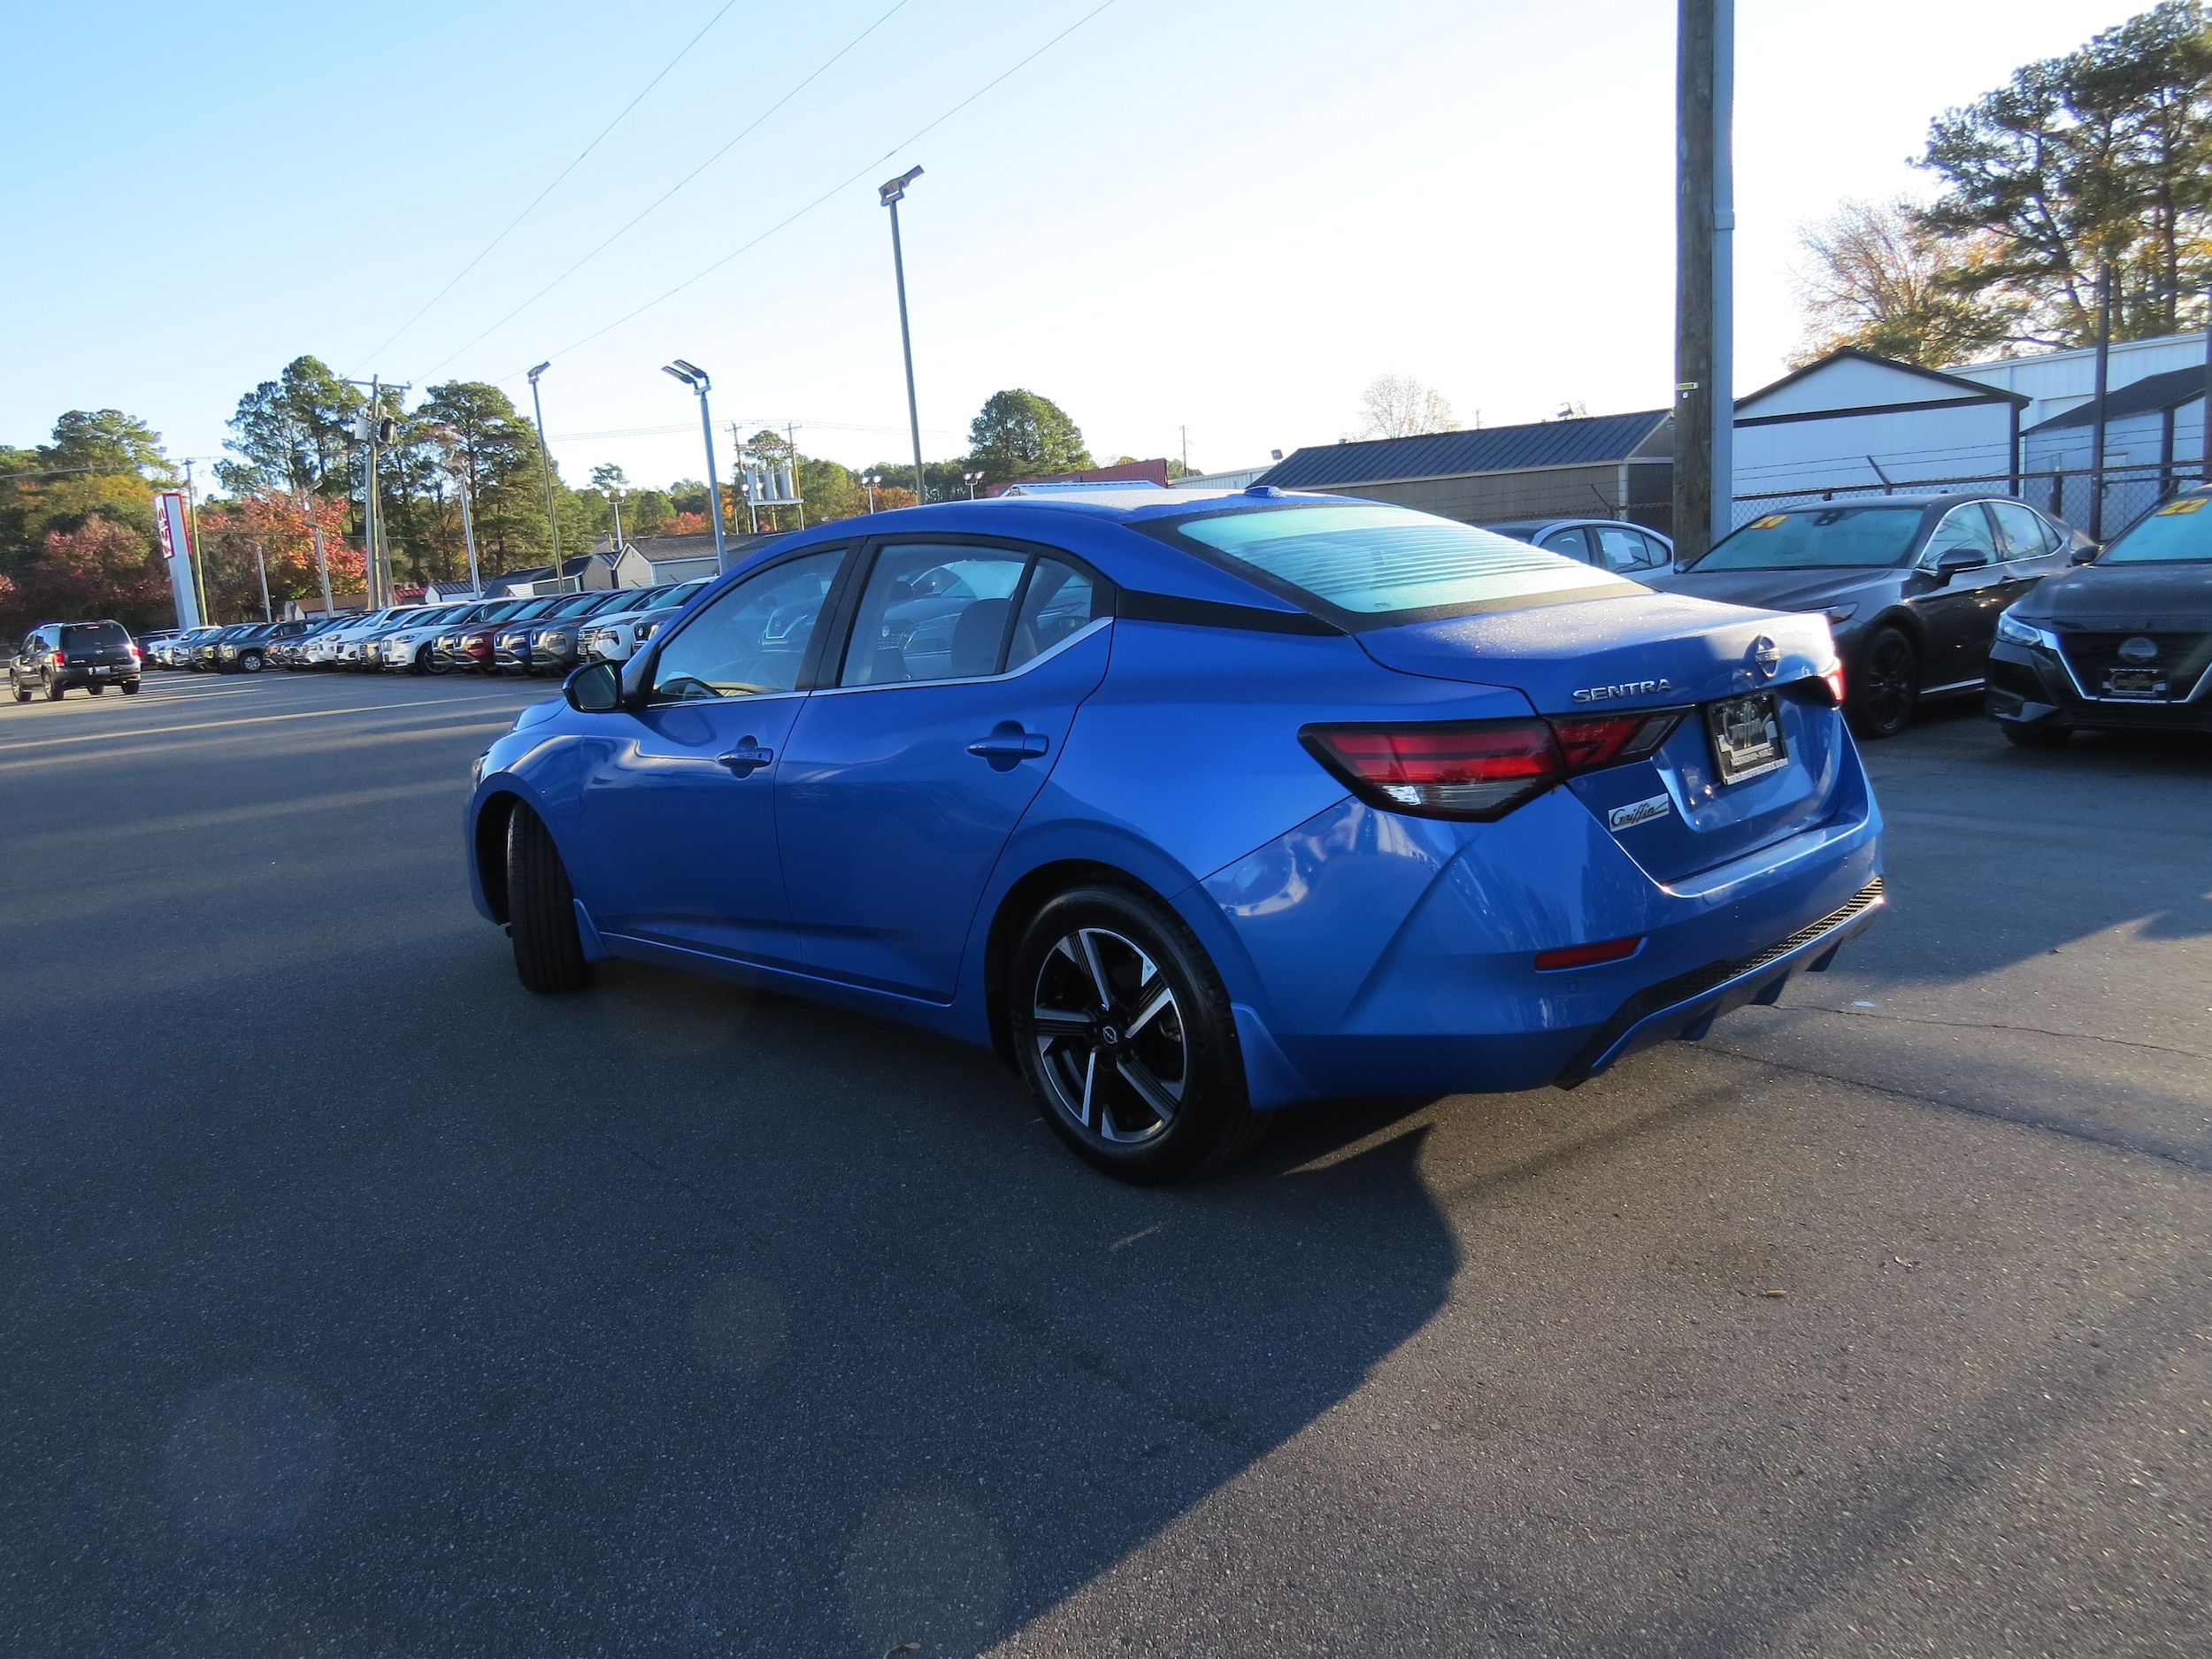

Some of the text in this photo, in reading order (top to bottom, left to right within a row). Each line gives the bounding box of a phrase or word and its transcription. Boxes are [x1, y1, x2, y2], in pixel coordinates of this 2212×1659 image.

[2157, 497, 2208, 515] 22
[1572, 678, 1671, 703] SENTRA
[1611, 801, 1669, 826] Griffin
